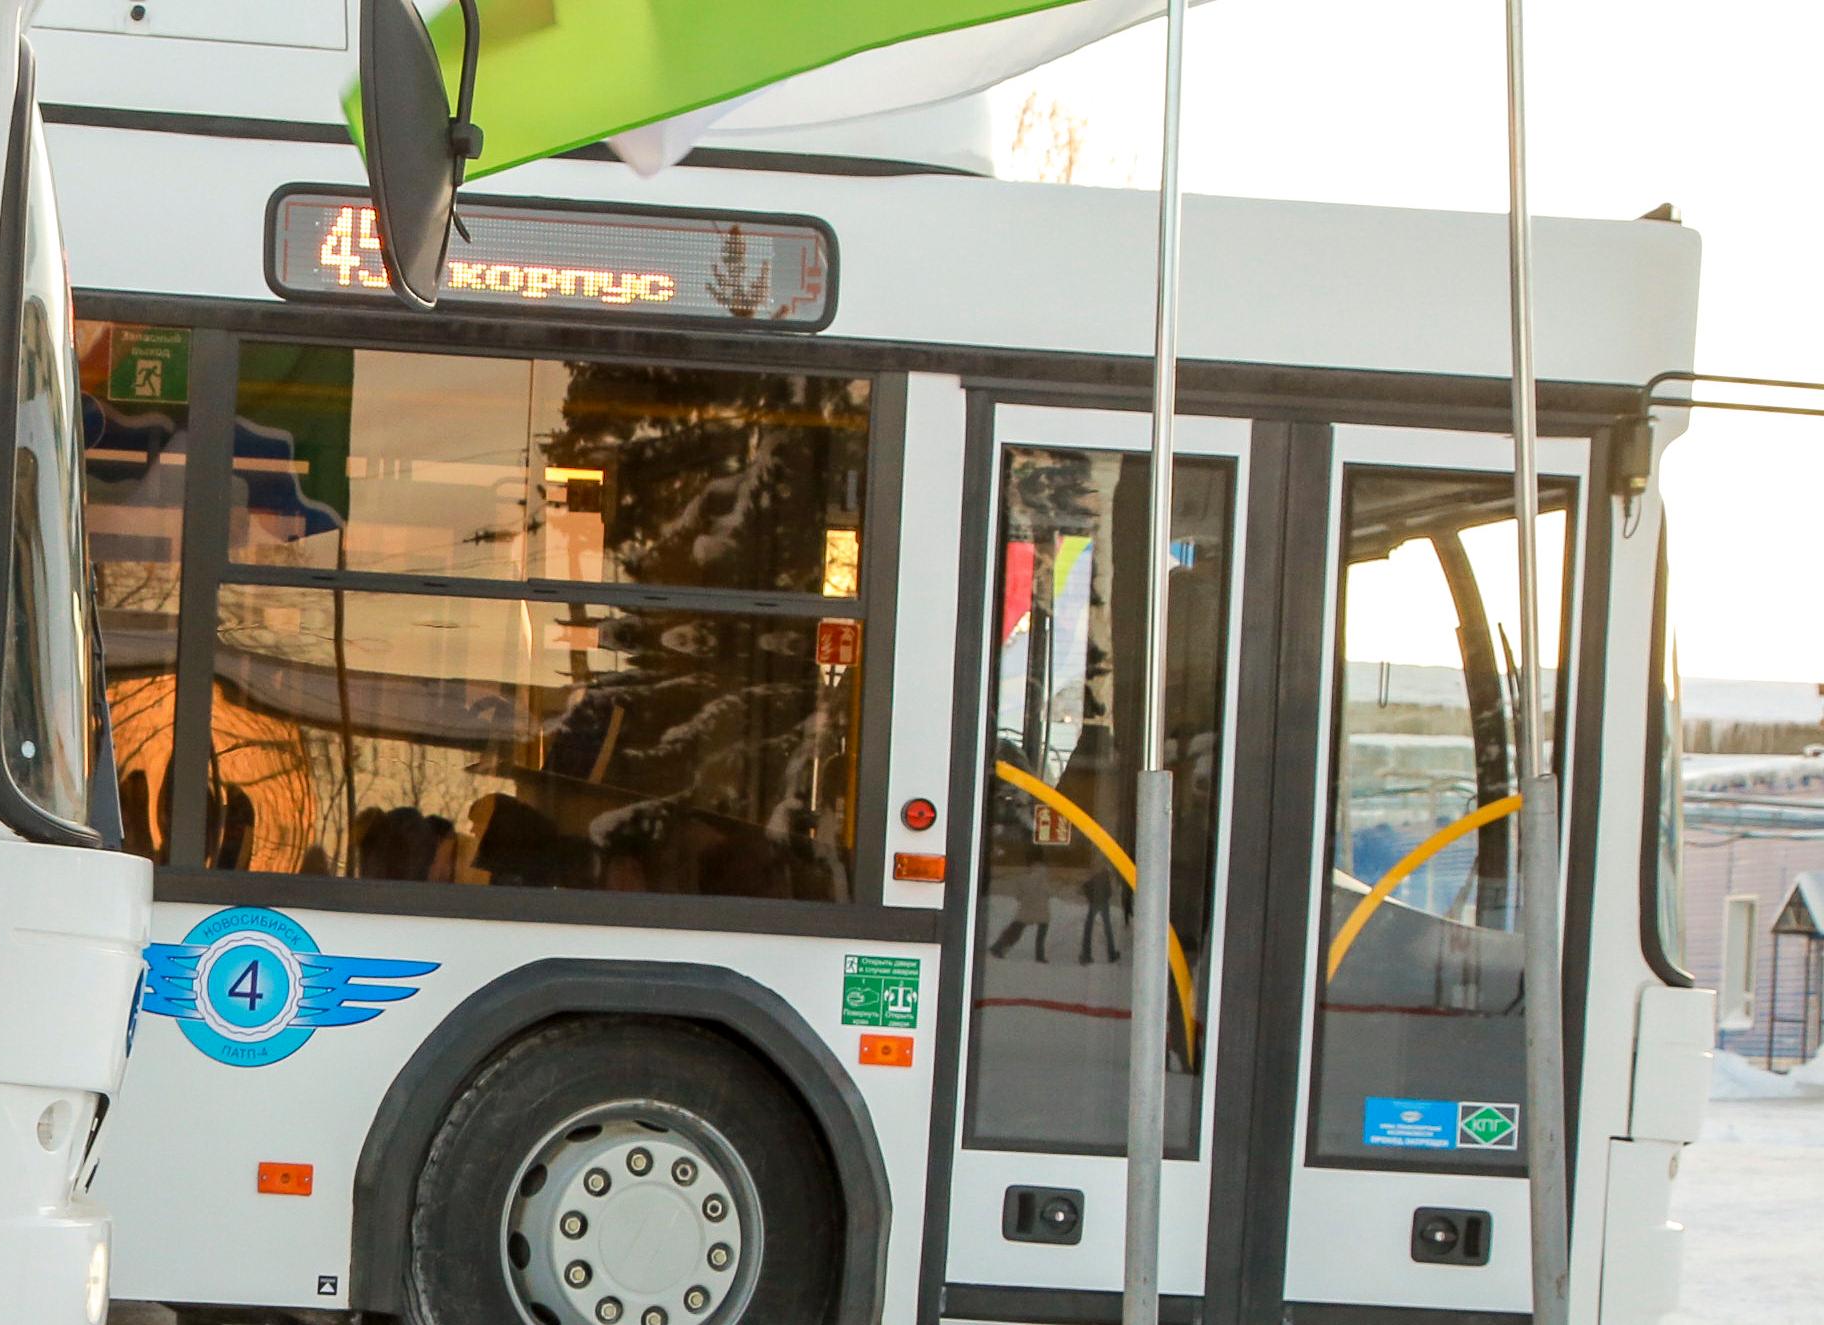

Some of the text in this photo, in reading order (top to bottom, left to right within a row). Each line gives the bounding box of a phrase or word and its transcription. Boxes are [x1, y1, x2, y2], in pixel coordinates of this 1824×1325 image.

[448, 261, 675, 304] корпус
[202, 914, 302, 946] НОВОСИБИРСК
[227, 959, 264, 1012] 4
[1472, 1117, 1505, 1132] КПГ
